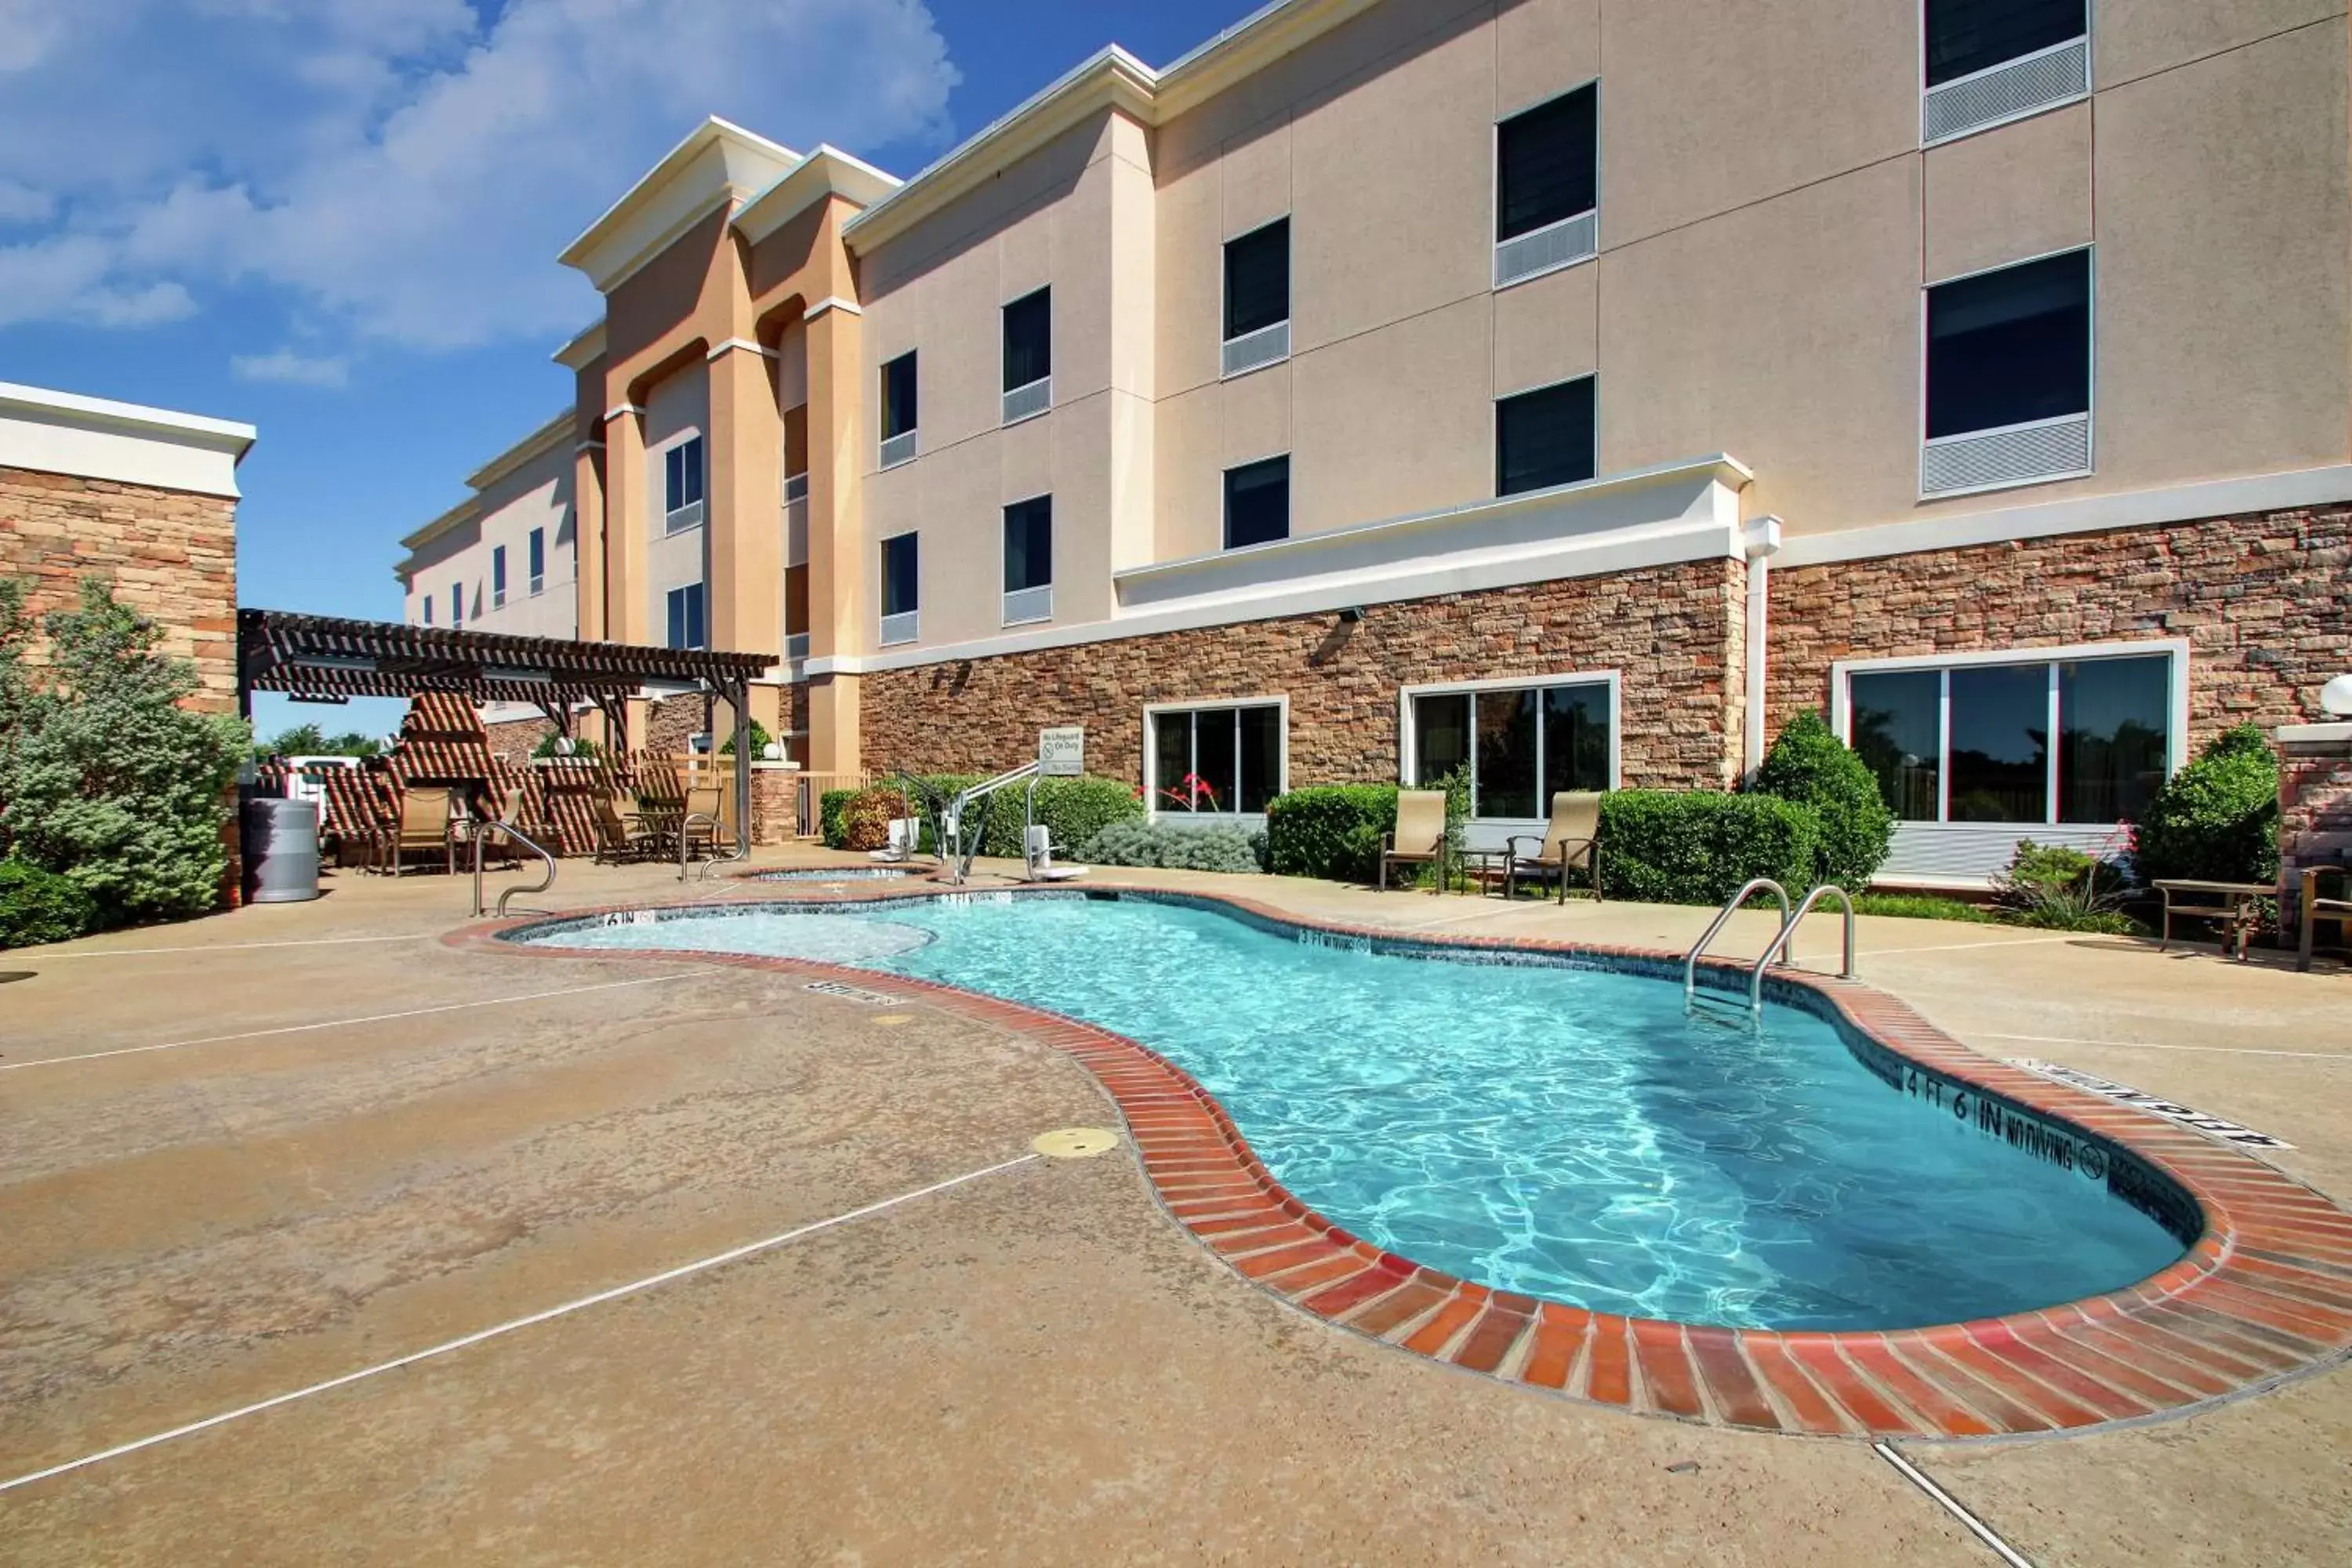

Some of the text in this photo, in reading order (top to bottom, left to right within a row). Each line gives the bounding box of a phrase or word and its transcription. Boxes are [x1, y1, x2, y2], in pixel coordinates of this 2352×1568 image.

[1051, 733, 1079, 742] Lifeguard
[1065, 742, 1079, 751] Duty
[608, 911, 634, 925] 6 IN
[1301, 929, 1308, 944] 3
[1312, 932, 1322, 946] FT
[1907, 1071, 2073, 1172] 4 FT 6 IN NO DIVING
